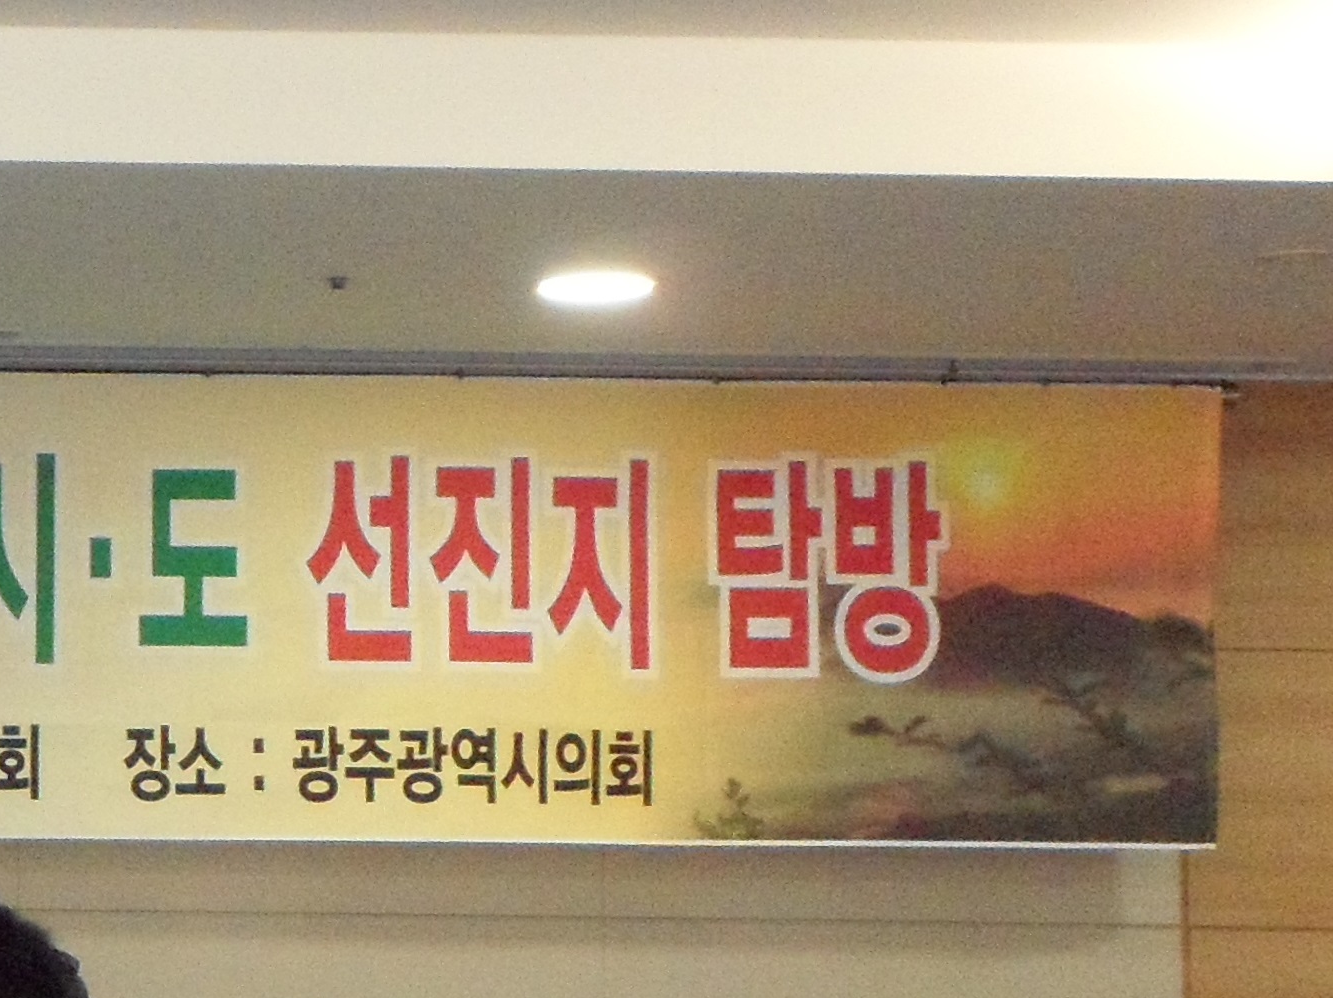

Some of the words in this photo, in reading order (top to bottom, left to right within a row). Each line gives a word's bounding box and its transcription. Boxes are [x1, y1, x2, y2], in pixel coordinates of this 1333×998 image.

[305, 454, 650, 671] 선진지
[714, 459, 941, 675] 탐방
[123, 725, 226, 802] 장소
[291, 727, 653, 806] 광주광역시의회
